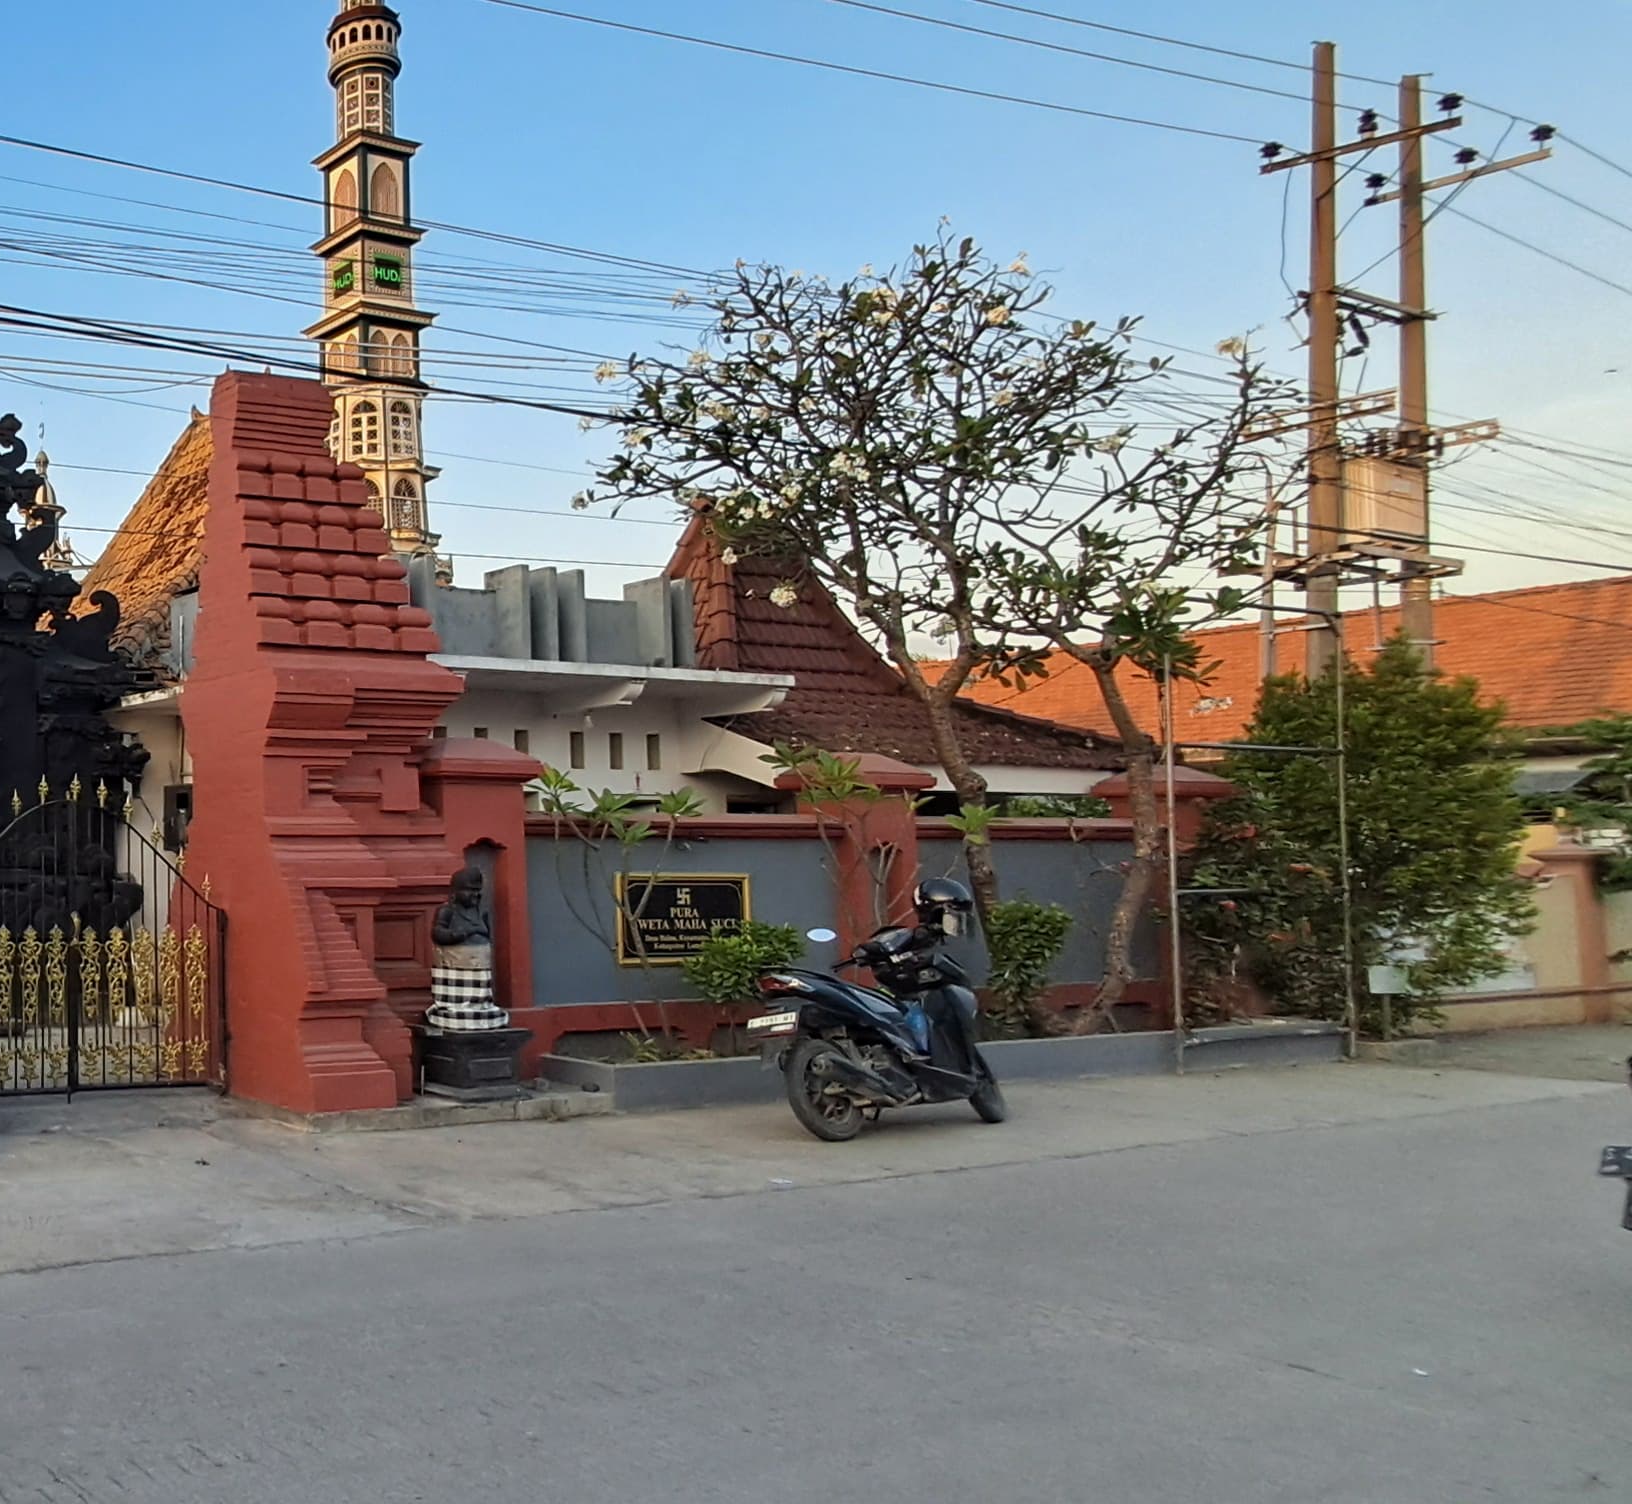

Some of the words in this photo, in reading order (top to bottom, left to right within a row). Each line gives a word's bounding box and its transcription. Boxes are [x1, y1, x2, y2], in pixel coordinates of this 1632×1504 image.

[670, 907, 700, 918] PURA
[637, 918, 670, 929] WETA
[674, 918, 707, 929] MAHA
